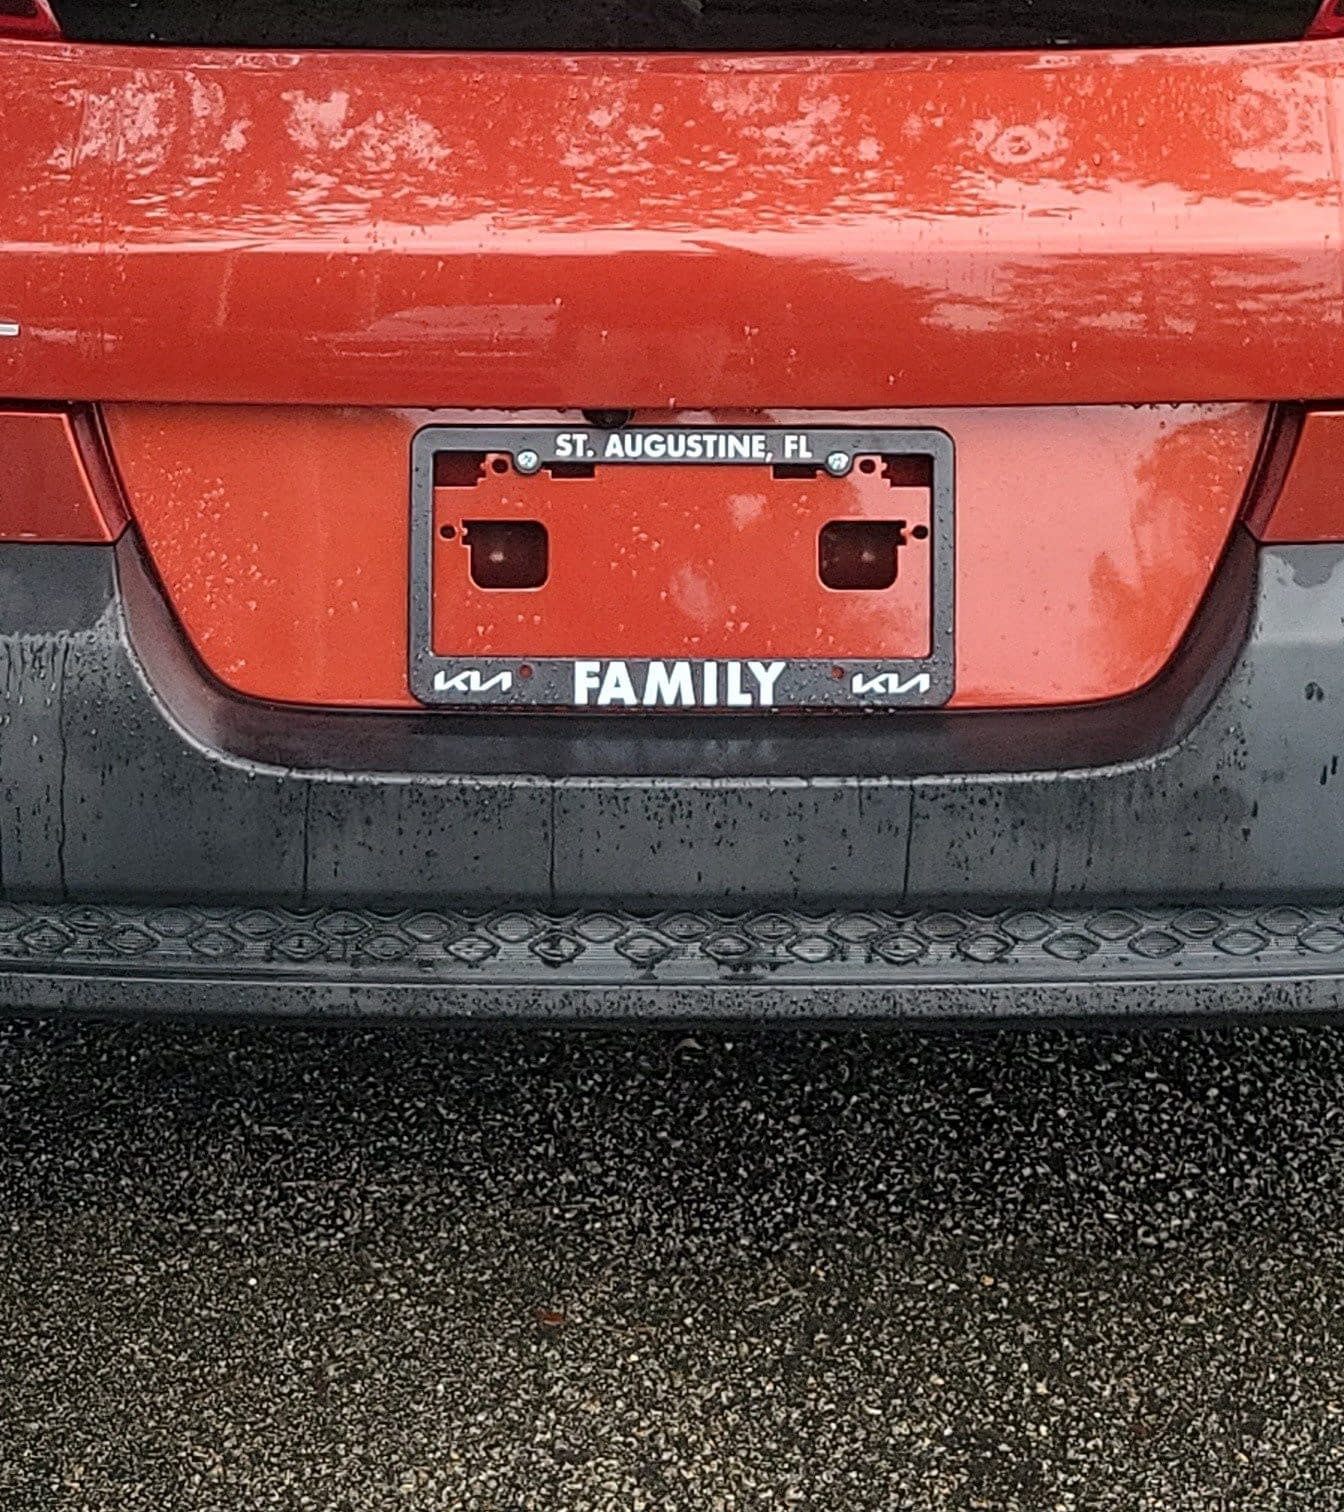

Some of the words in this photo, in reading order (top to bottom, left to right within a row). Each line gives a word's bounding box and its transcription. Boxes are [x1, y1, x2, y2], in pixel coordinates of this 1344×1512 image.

[555, 433, 595, 458] ST.
[605, 435, 775, 462] AUGUSTINE,
[783, 436, 813, 460] FL
[434, 670, 513, 693] KIA
[573, 661, 786, 707] FAMILY
[852, 672, 931, 695] KIA
